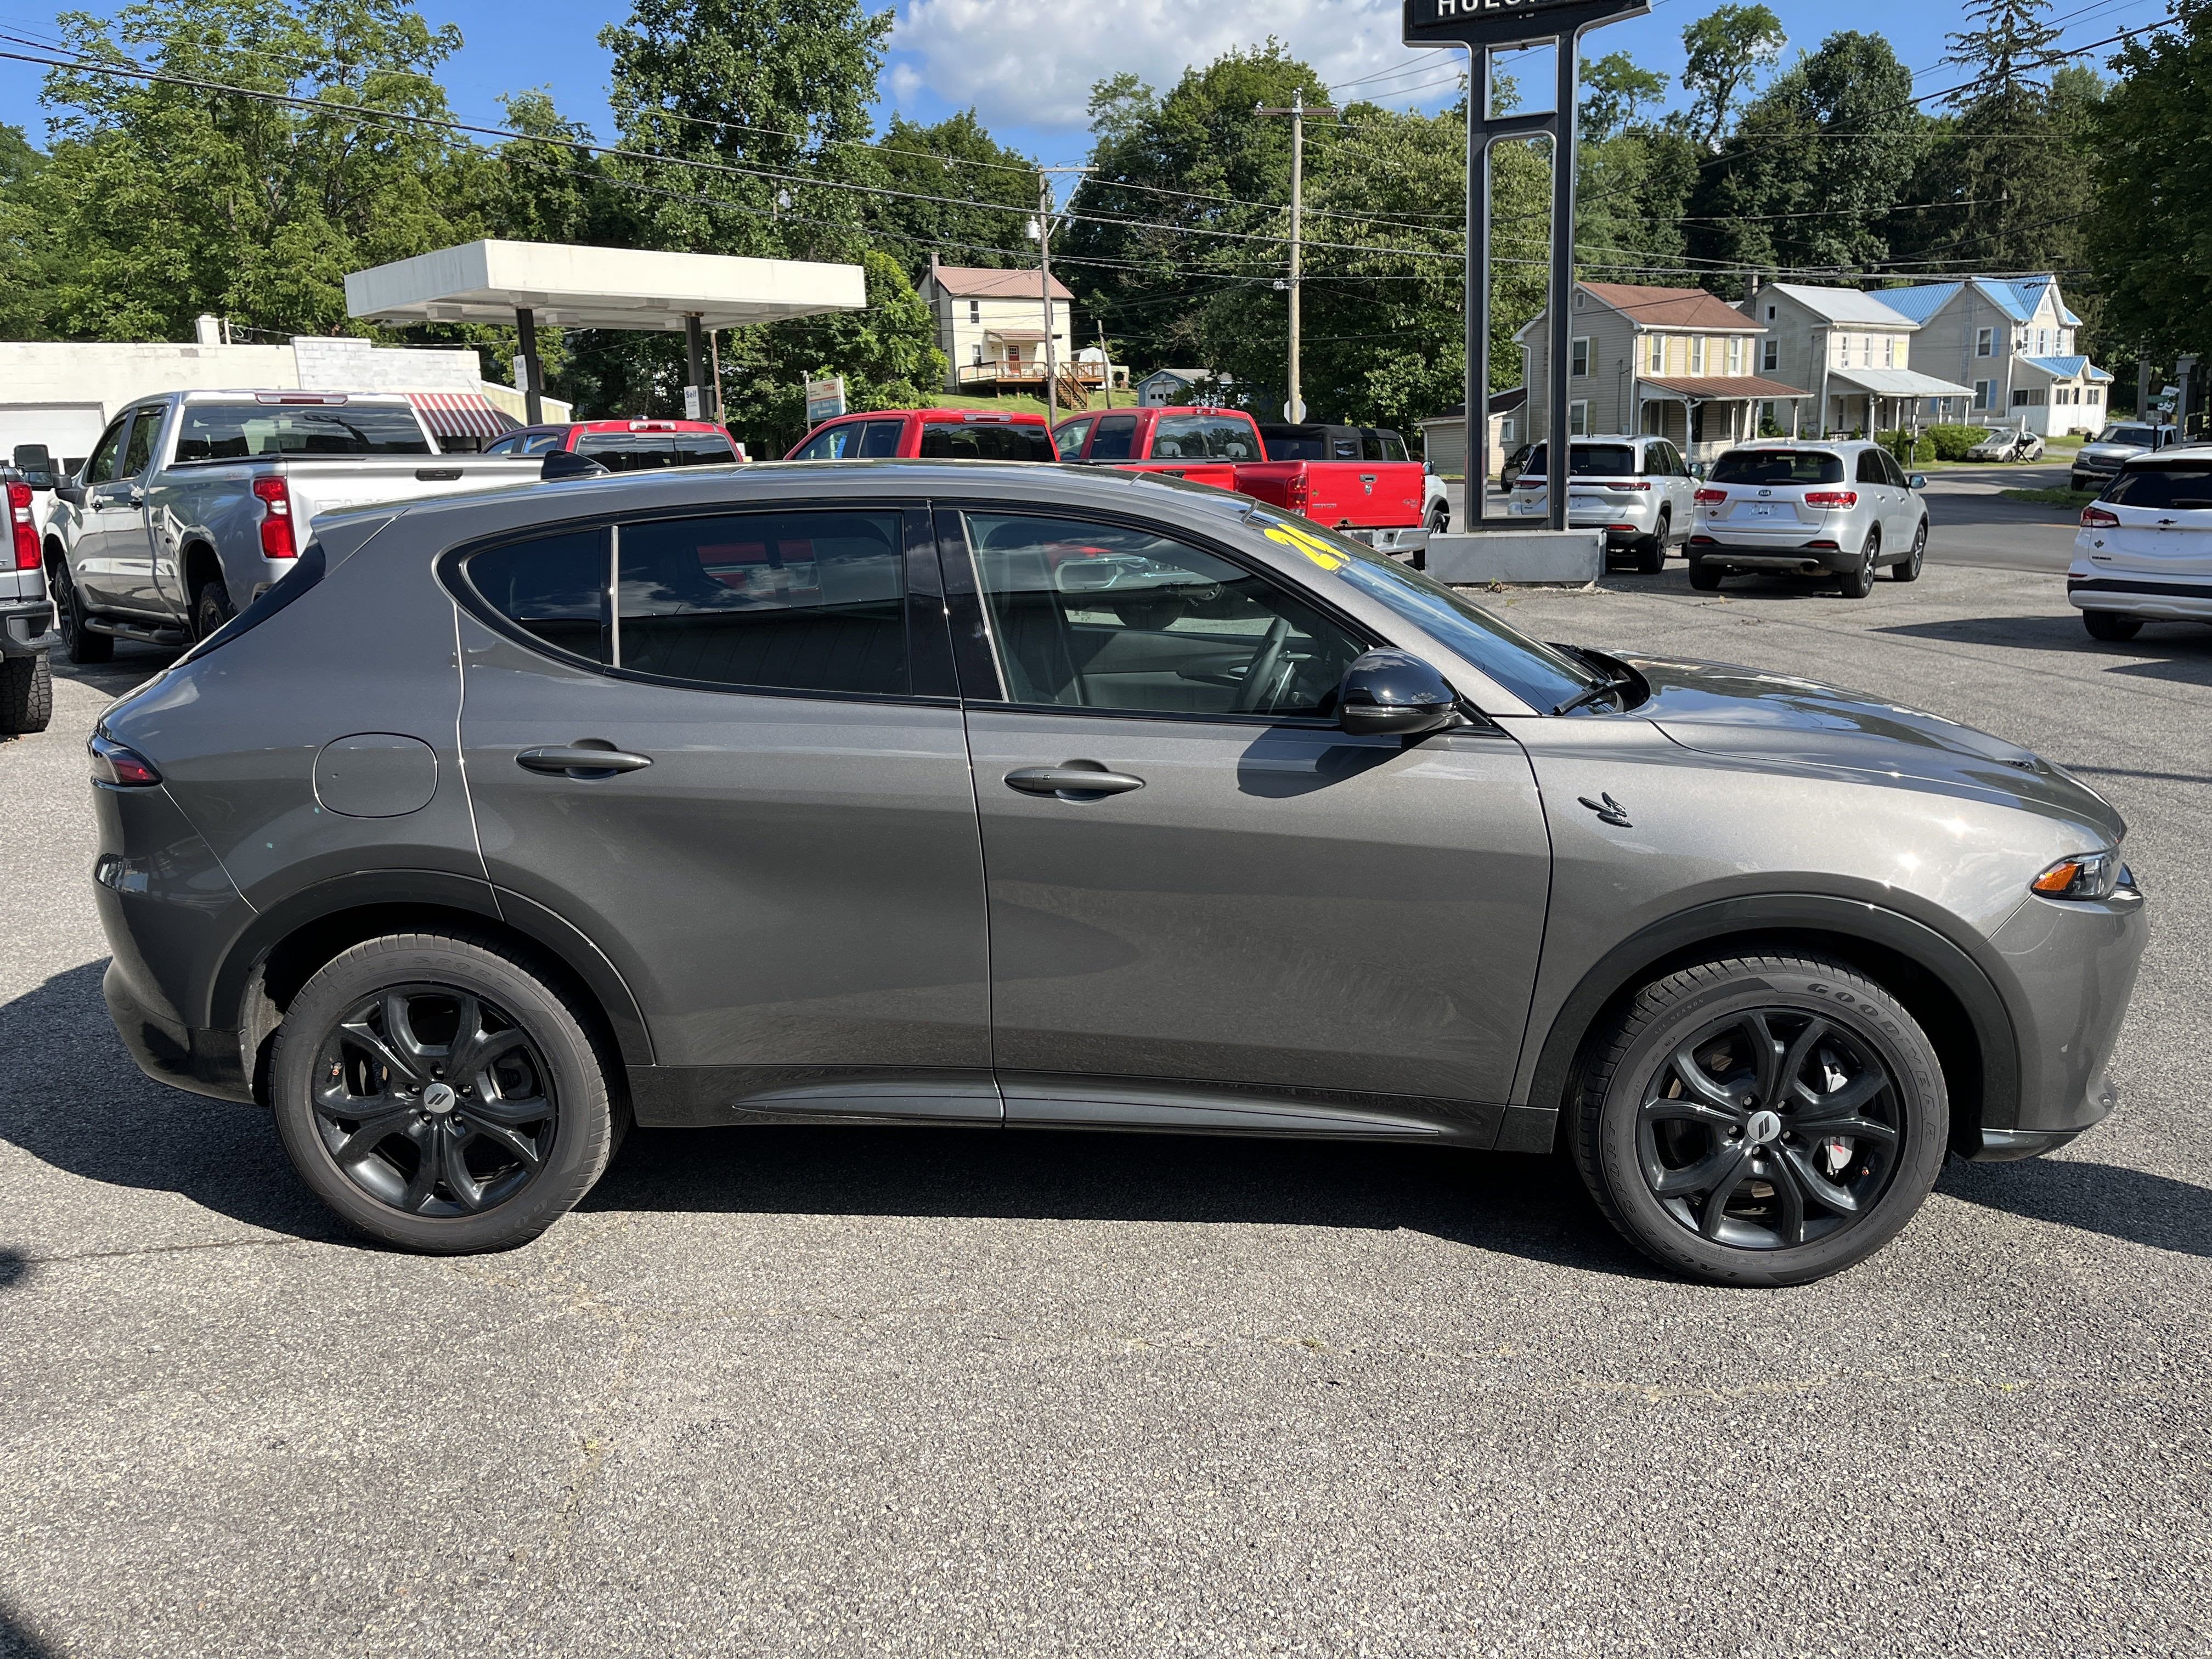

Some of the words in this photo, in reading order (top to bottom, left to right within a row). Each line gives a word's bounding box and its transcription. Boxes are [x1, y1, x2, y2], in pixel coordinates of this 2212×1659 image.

[686, 390, 697, 398] Self
[1263, 523, 1351, 571] 24
[412, 956, 513, 988] SPORT
[1671, 998, 1704, 1021] SEASON
[1808, 983, 1936, 1142] GOODYEAR
[1606, 1120, 1637, 1216] SPORT
[1640, 1226, 1739, 1278] EAGLE
